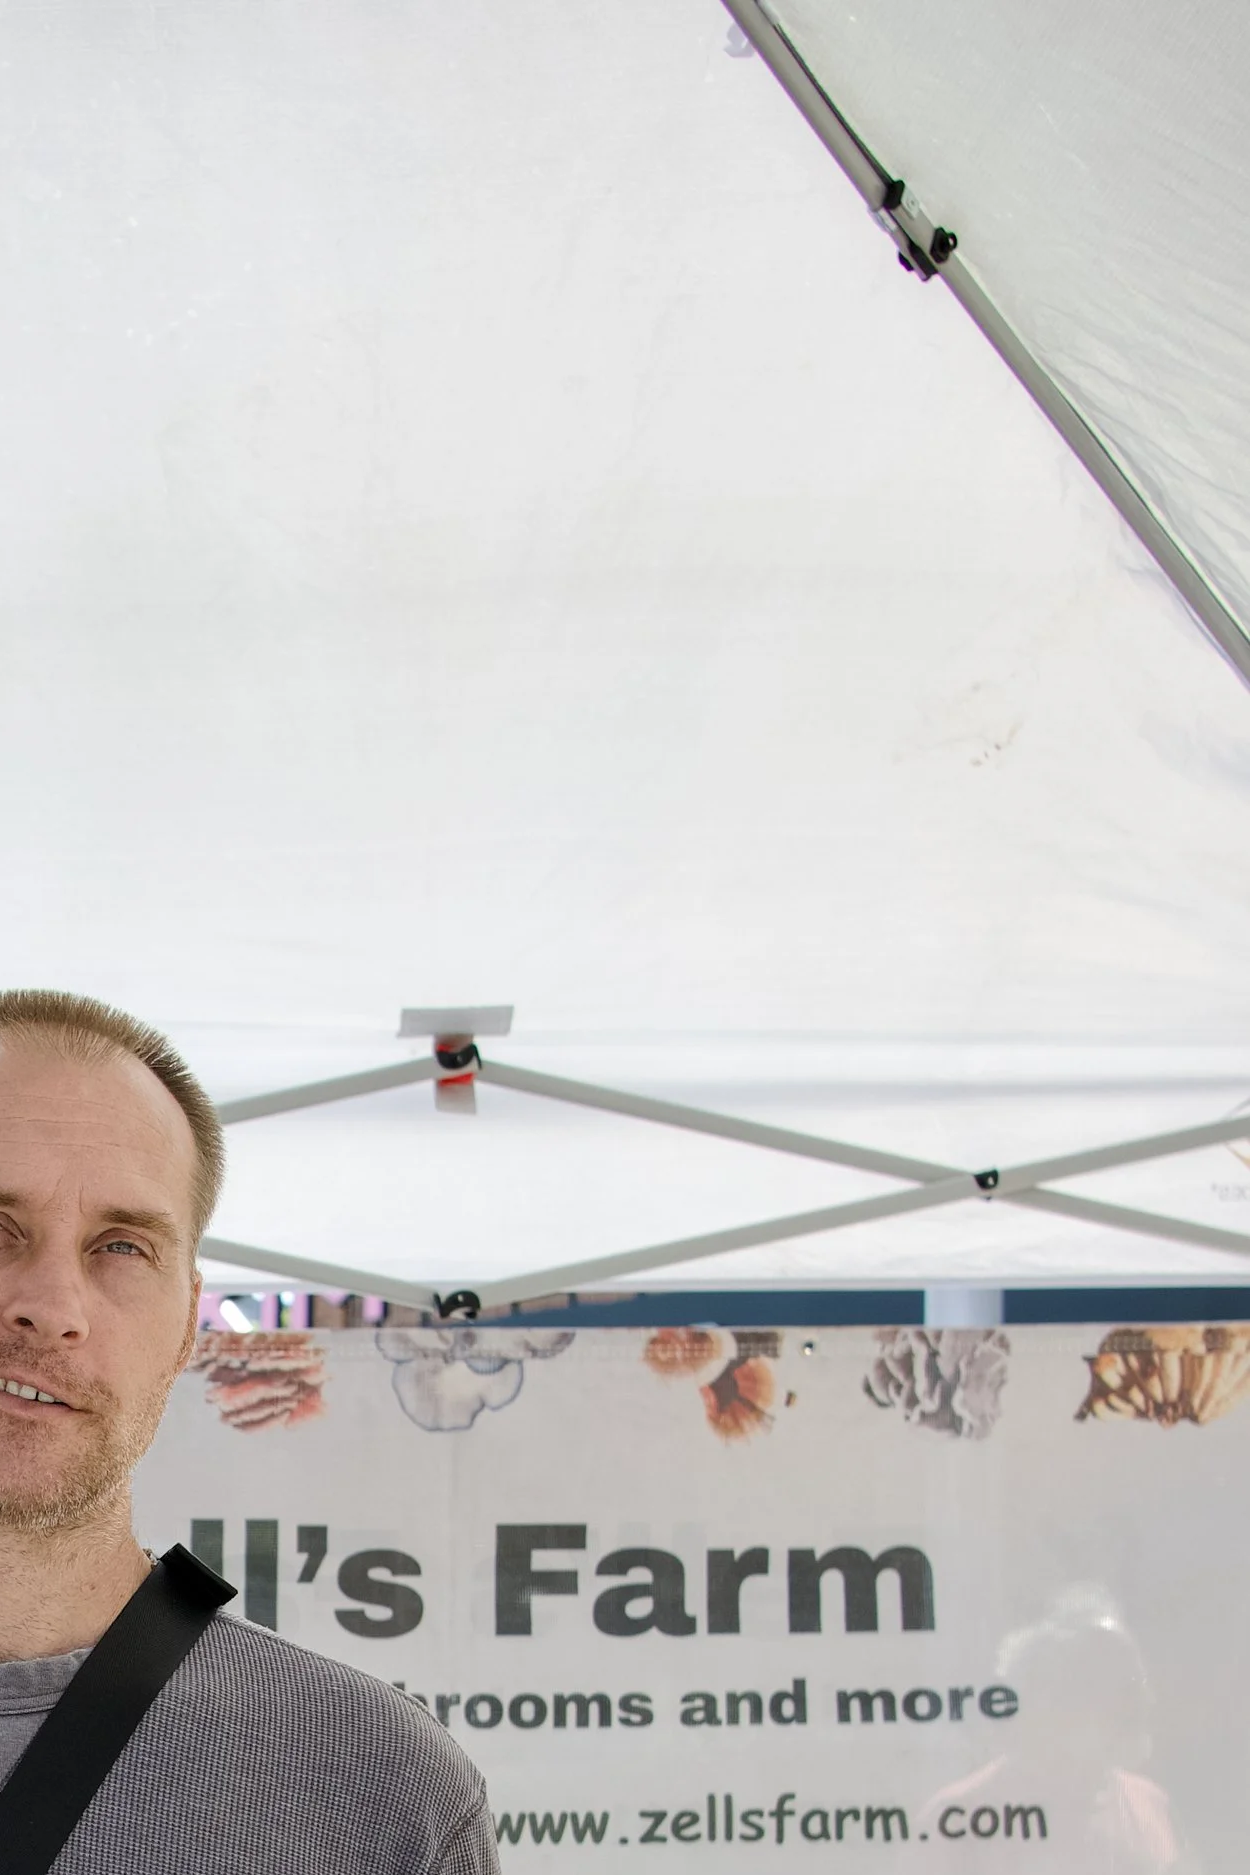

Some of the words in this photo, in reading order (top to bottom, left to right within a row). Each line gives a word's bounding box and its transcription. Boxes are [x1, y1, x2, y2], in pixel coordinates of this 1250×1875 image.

[494, 1523, 936, 1638] Farm
[391, 1679, 655, 1730] rooms
[679, 1677, 808, 1727] and
[835, 1684, 1020, 1724] more
[492, 1792, 1048, 1845] www.zellsfarm.com
